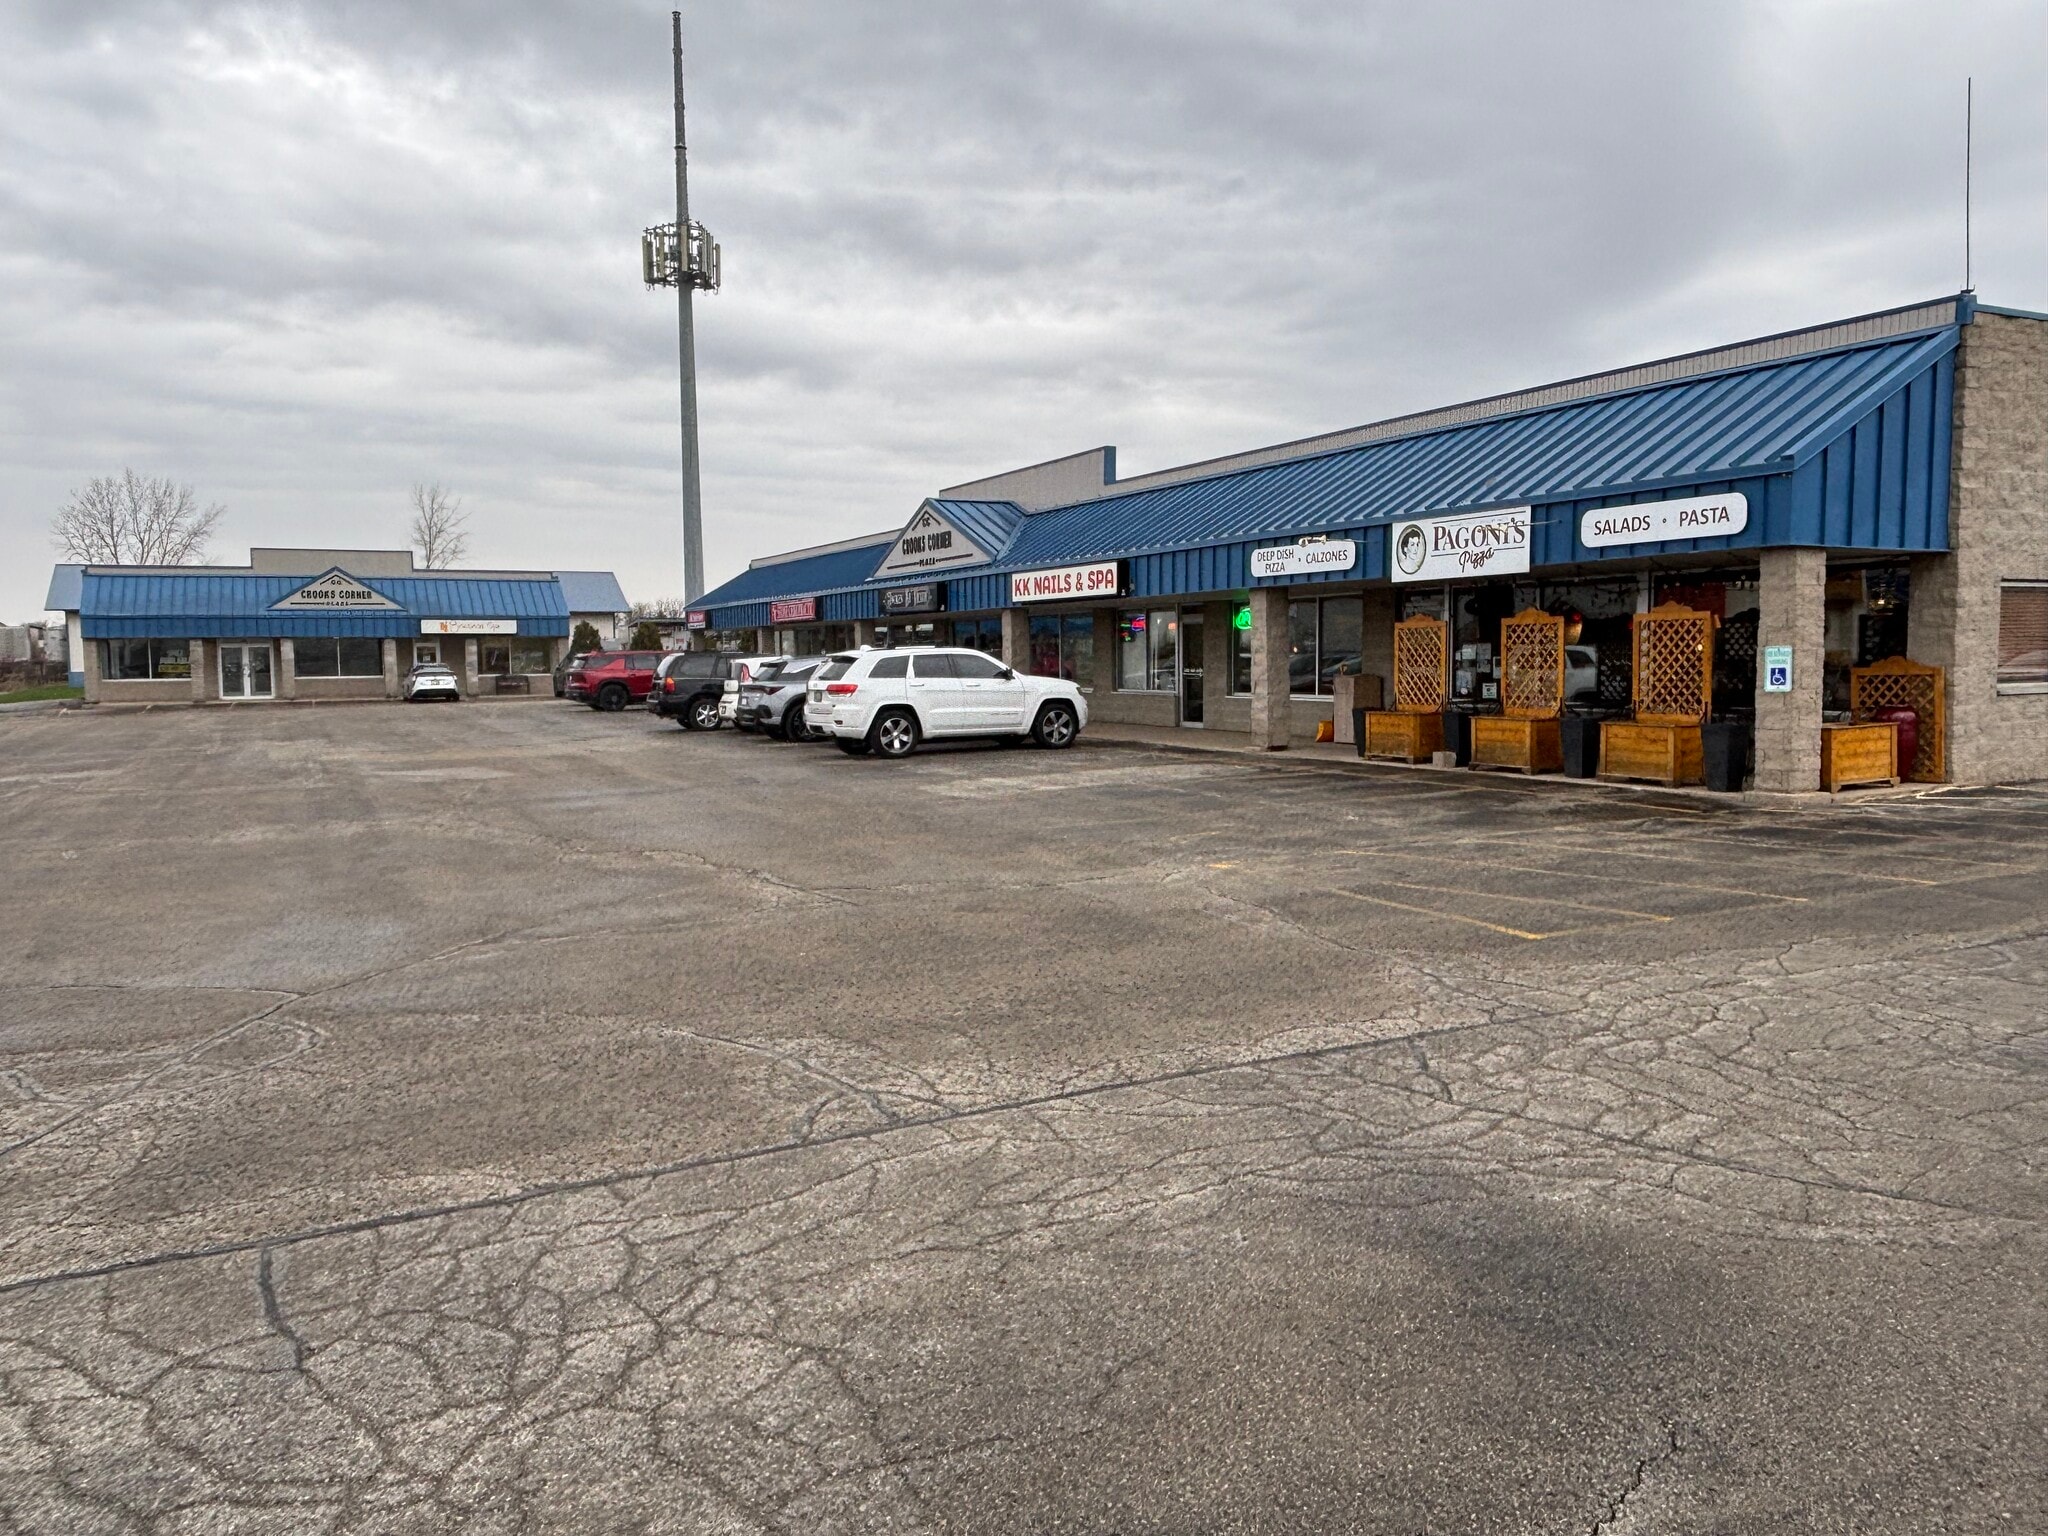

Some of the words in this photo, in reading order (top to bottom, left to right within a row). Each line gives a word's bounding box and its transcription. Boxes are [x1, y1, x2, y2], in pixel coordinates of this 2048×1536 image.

[1594, 515, 1651, 536] SALADS
[1679, 506, 1730, 527] PASTA
[902, 535, 926, 555] CROOKS
[927, 530, 952, 551] CORNER
[1432, 517, 1525, 552] PAGONI'S
[1257, 551, 1275, 562] DEEP
[1276, 548, 1294, 559] DISH
[1264, 562, 1285, 573] PIZZA
[1305, 549, 1348, 564] CALZONES
[1458, 546, 1495, 573] Pizza
[301, 590, 336, 599] CROOKS
[338, 590, 372, 599] CORNER
[1014, 577, 1031, 597] KK
[1033, 573, 1072, 595] NAILS
[1075, 572, 1083, 592] &
[1087, 568, 1114, 590] SPA
